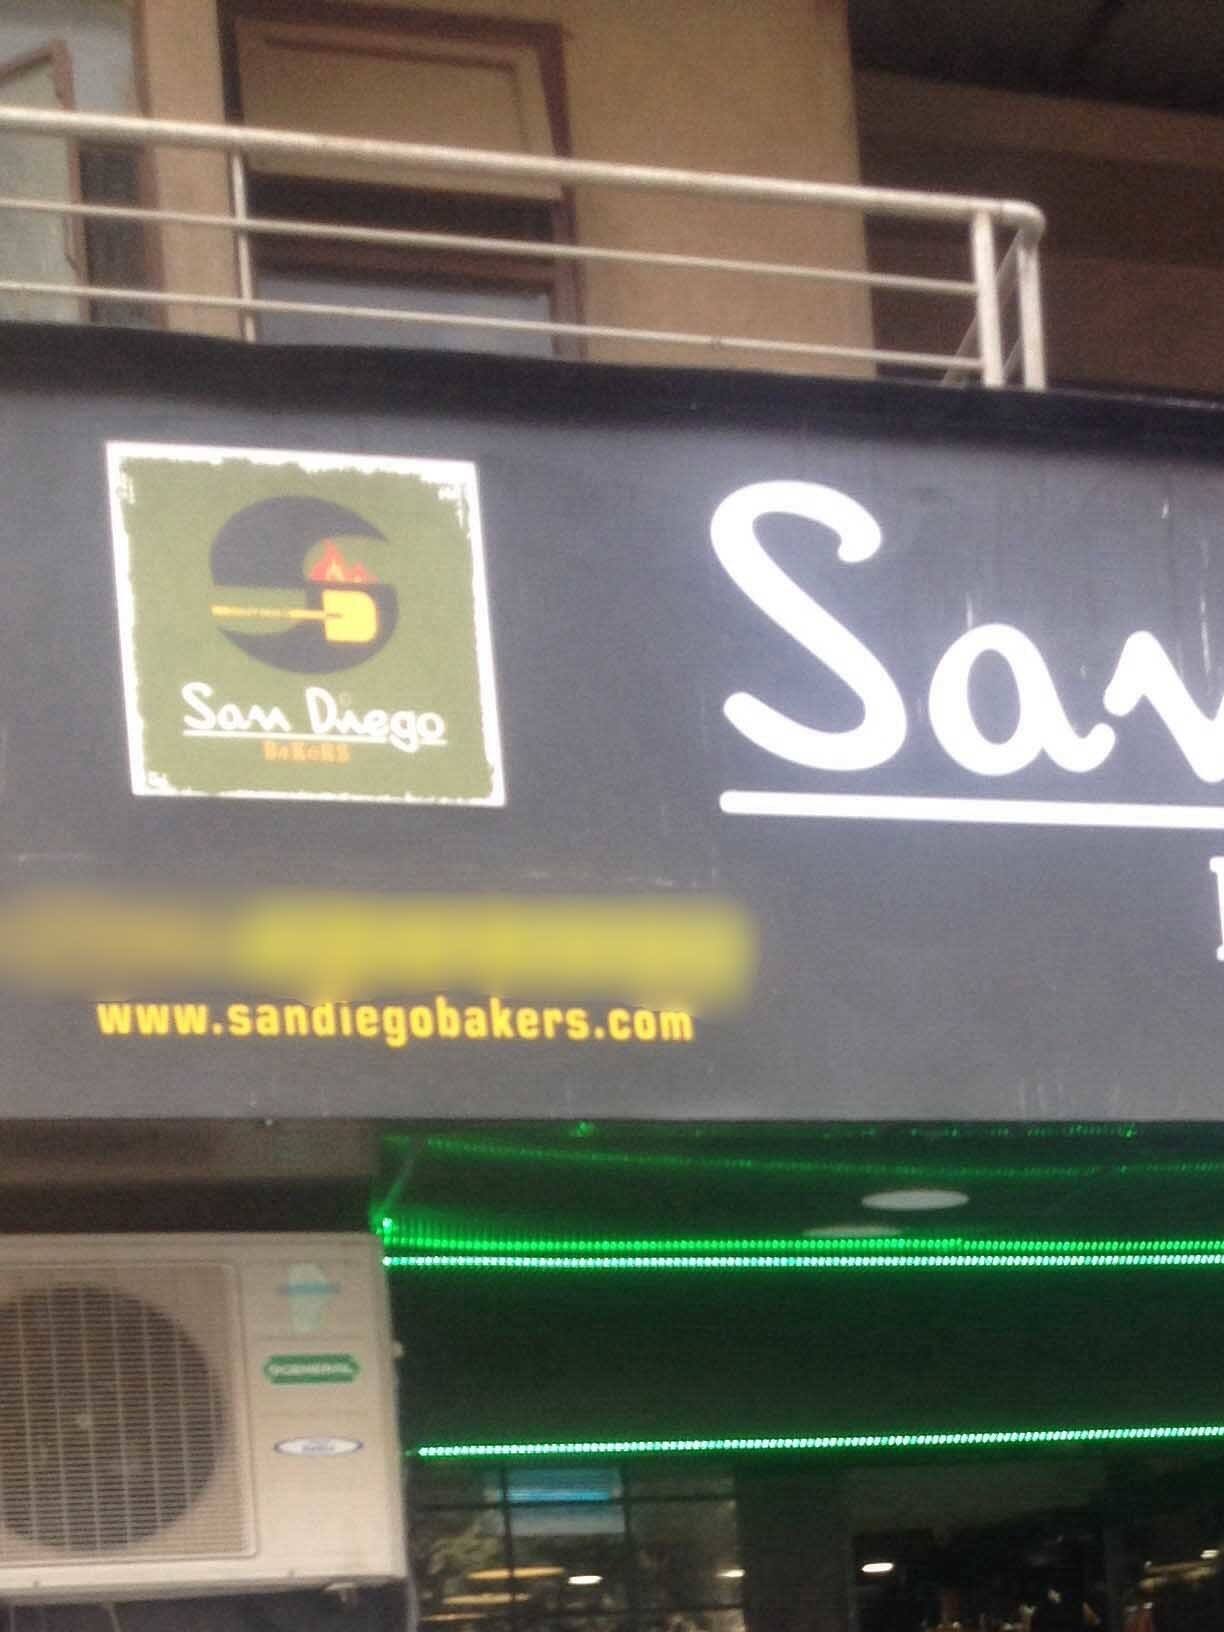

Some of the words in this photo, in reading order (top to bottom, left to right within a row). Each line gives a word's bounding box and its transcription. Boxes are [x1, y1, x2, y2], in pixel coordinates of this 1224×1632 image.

[181, 681, 291, 732] San
[304, 686, 446, 753] Diego
[97, 997, 694, 1048] www.sandiegobakers.com
